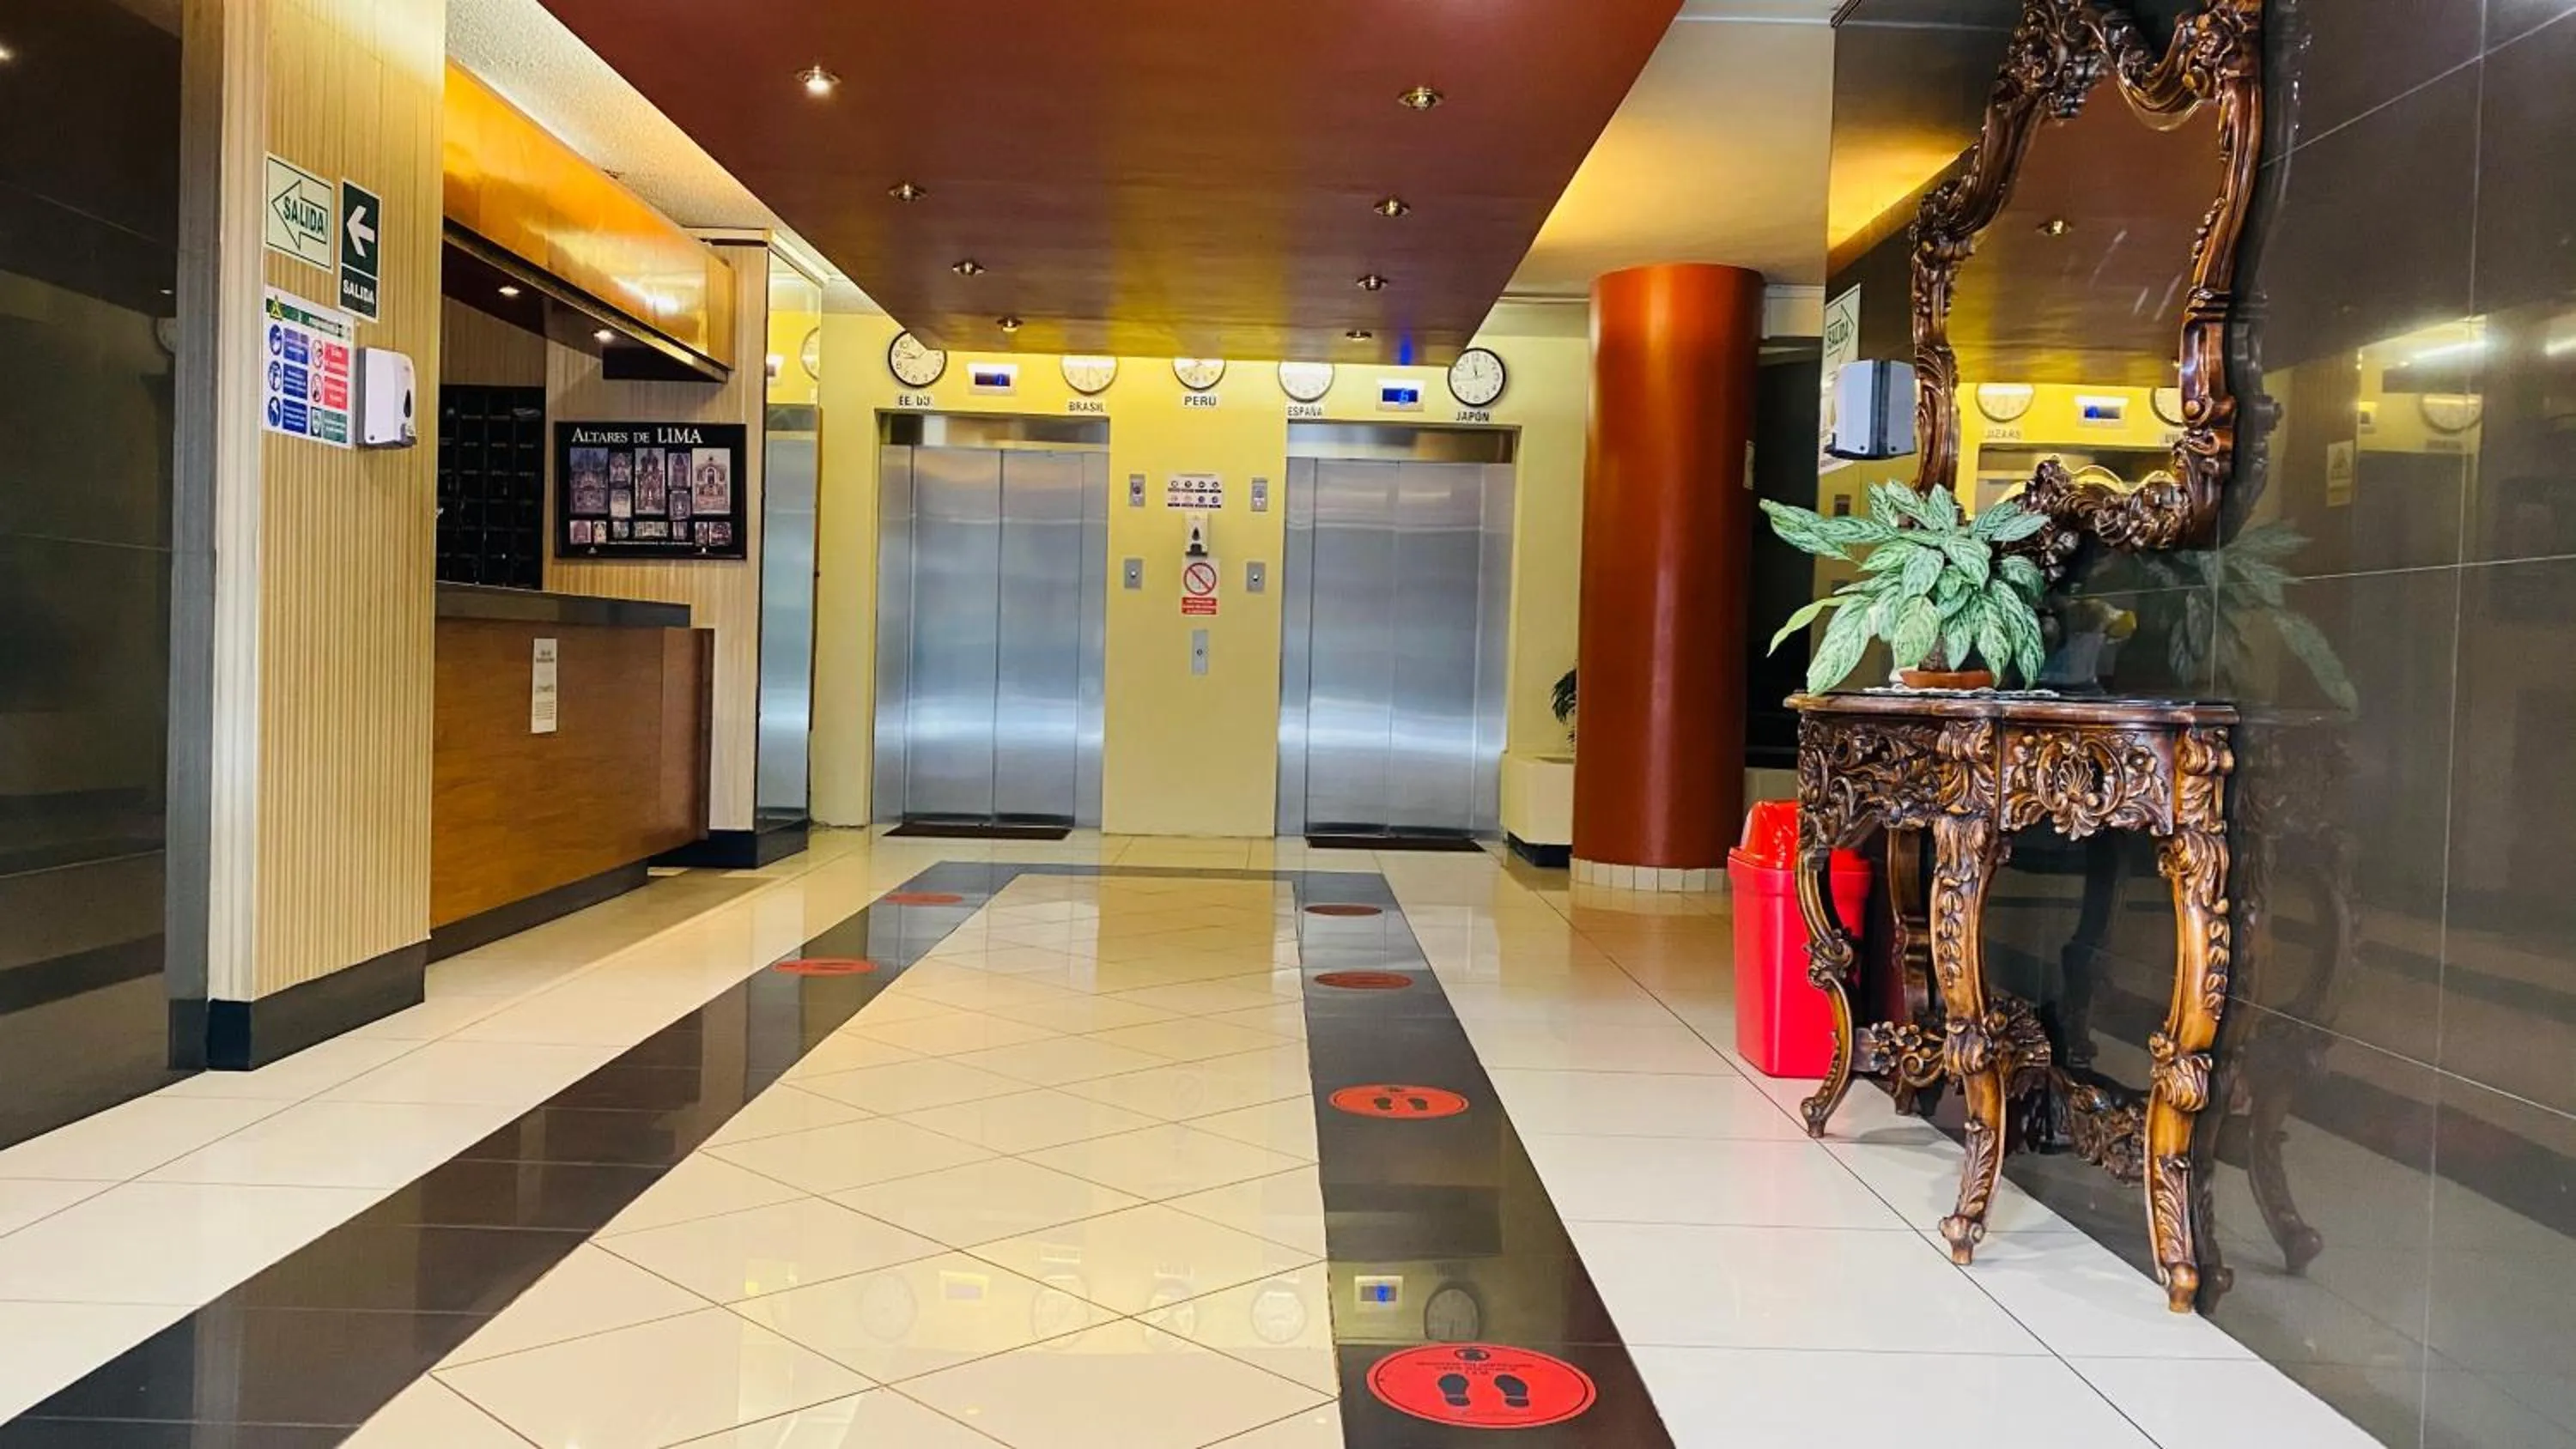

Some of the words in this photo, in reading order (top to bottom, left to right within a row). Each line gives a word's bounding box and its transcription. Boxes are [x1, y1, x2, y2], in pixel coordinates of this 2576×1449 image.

[283, 195, 325, 236] SALIDA
[343, 279, 375, 305] SALIDA
[1068, 400, 1104, 413] BRASIL
[571, 427, 629, 444] ALTARES
[656, 427, 704, 444] LIMA
